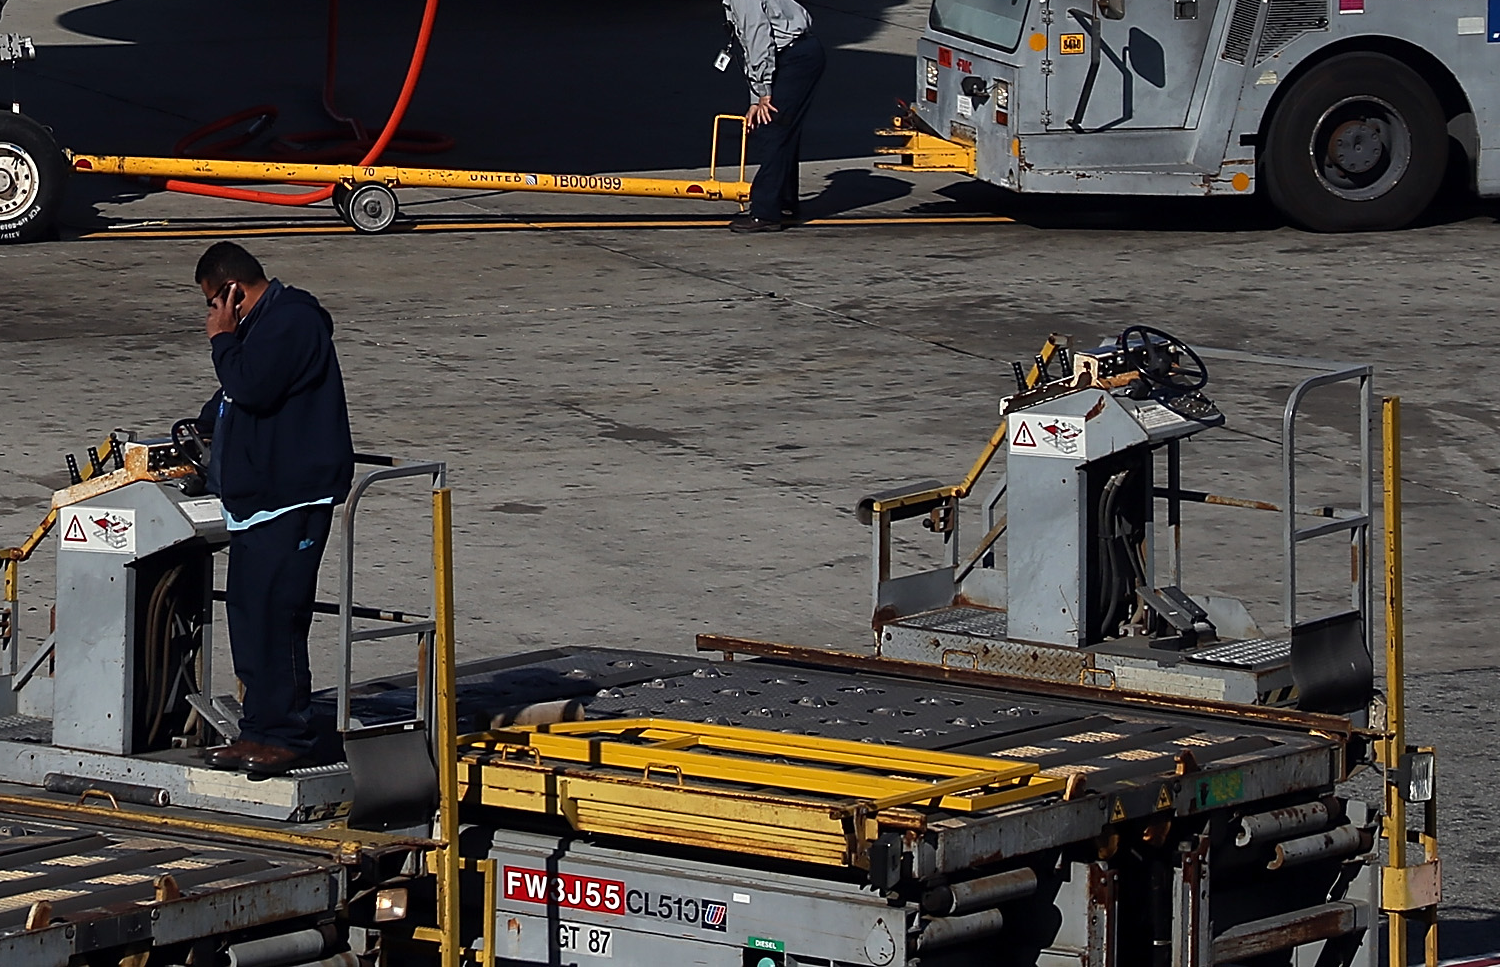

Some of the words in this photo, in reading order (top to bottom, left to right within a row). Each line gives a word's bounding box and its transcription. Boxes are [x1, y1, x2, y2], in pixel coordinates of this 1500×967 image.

[362, 167, 375, 177] 70
[470, 174, 522, 183] UNITED
[506, 870, 621, 911] FW3J55
[588, 928, 612, 954] 87
[754, 938, 777, 950] DIESEL
